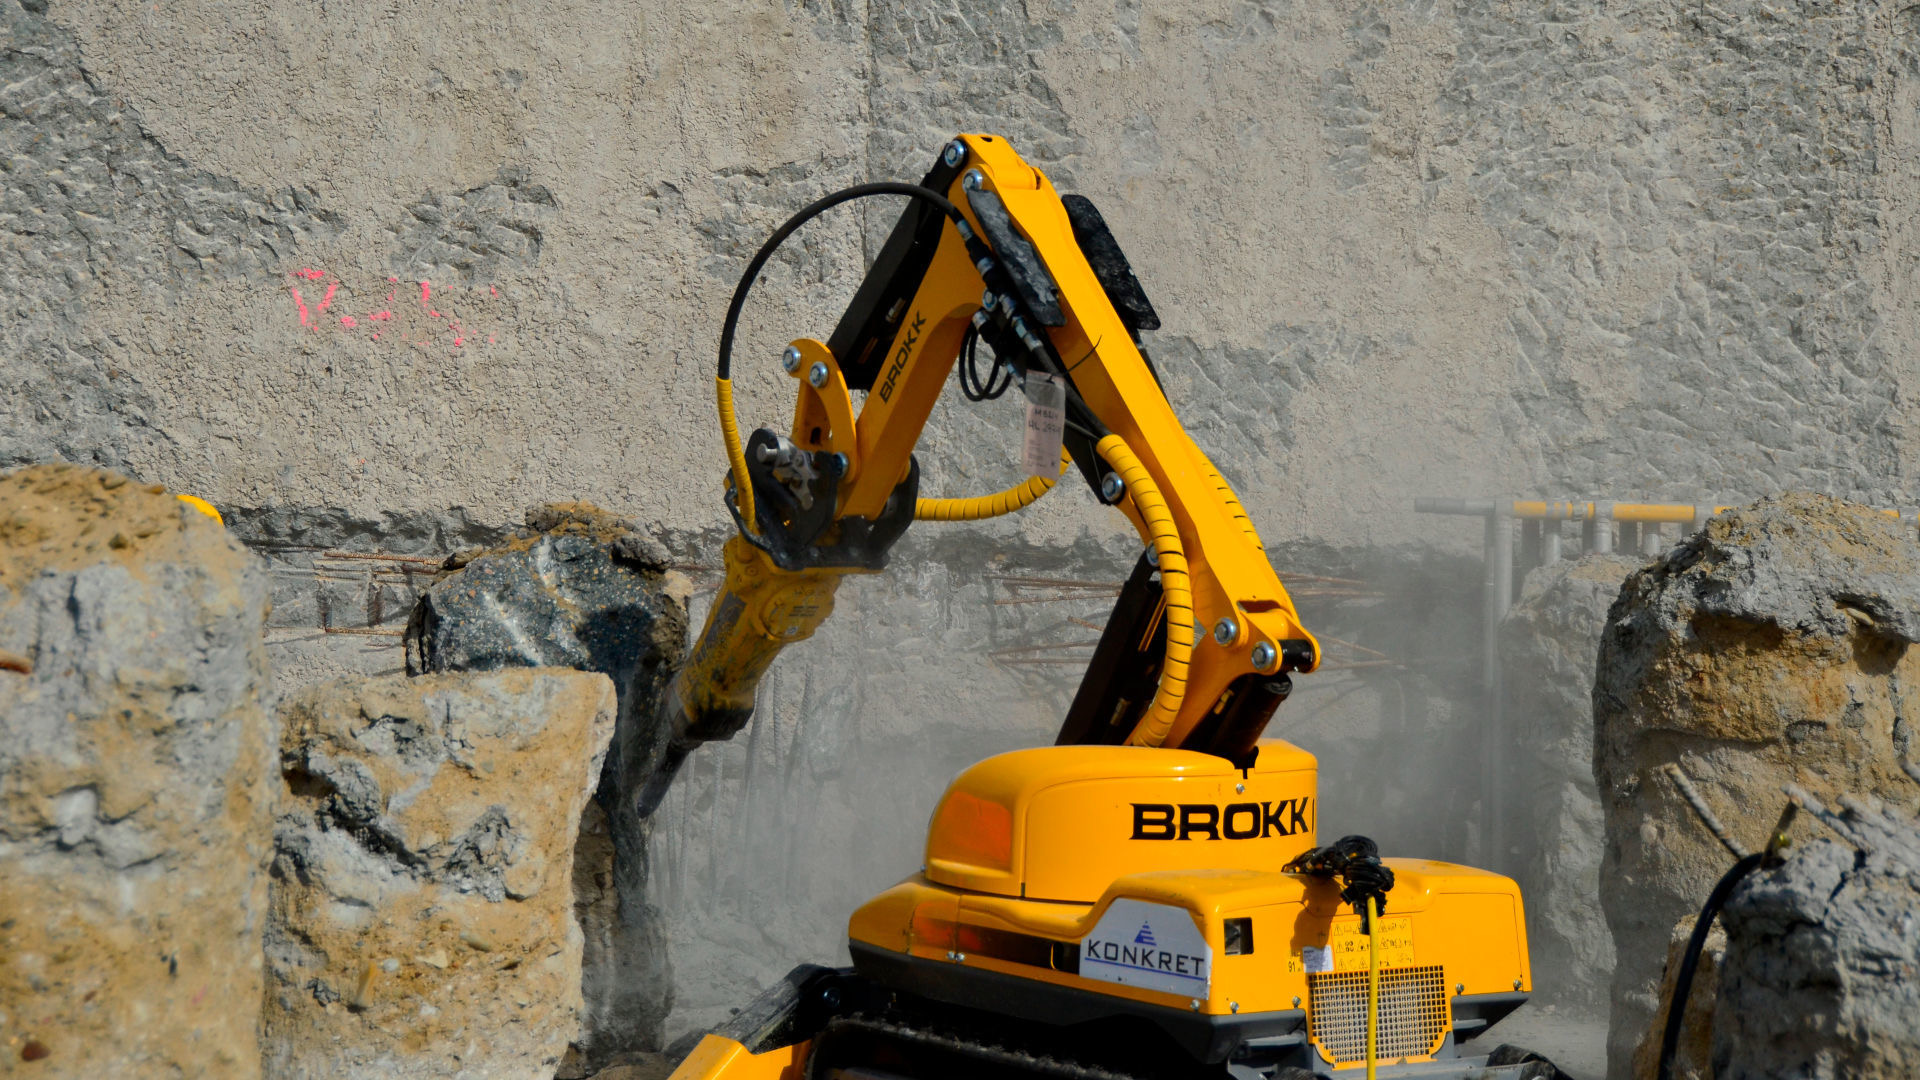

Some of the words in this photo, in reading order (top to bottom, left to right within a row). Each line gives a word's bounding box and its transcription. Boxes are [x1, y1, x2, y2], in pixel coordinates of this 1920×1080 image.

[879, 309, 927, 405] BROKK
[1129, 796, 1309, 841] BROKK
[1088, 938, 1205, 976] KONKRET
